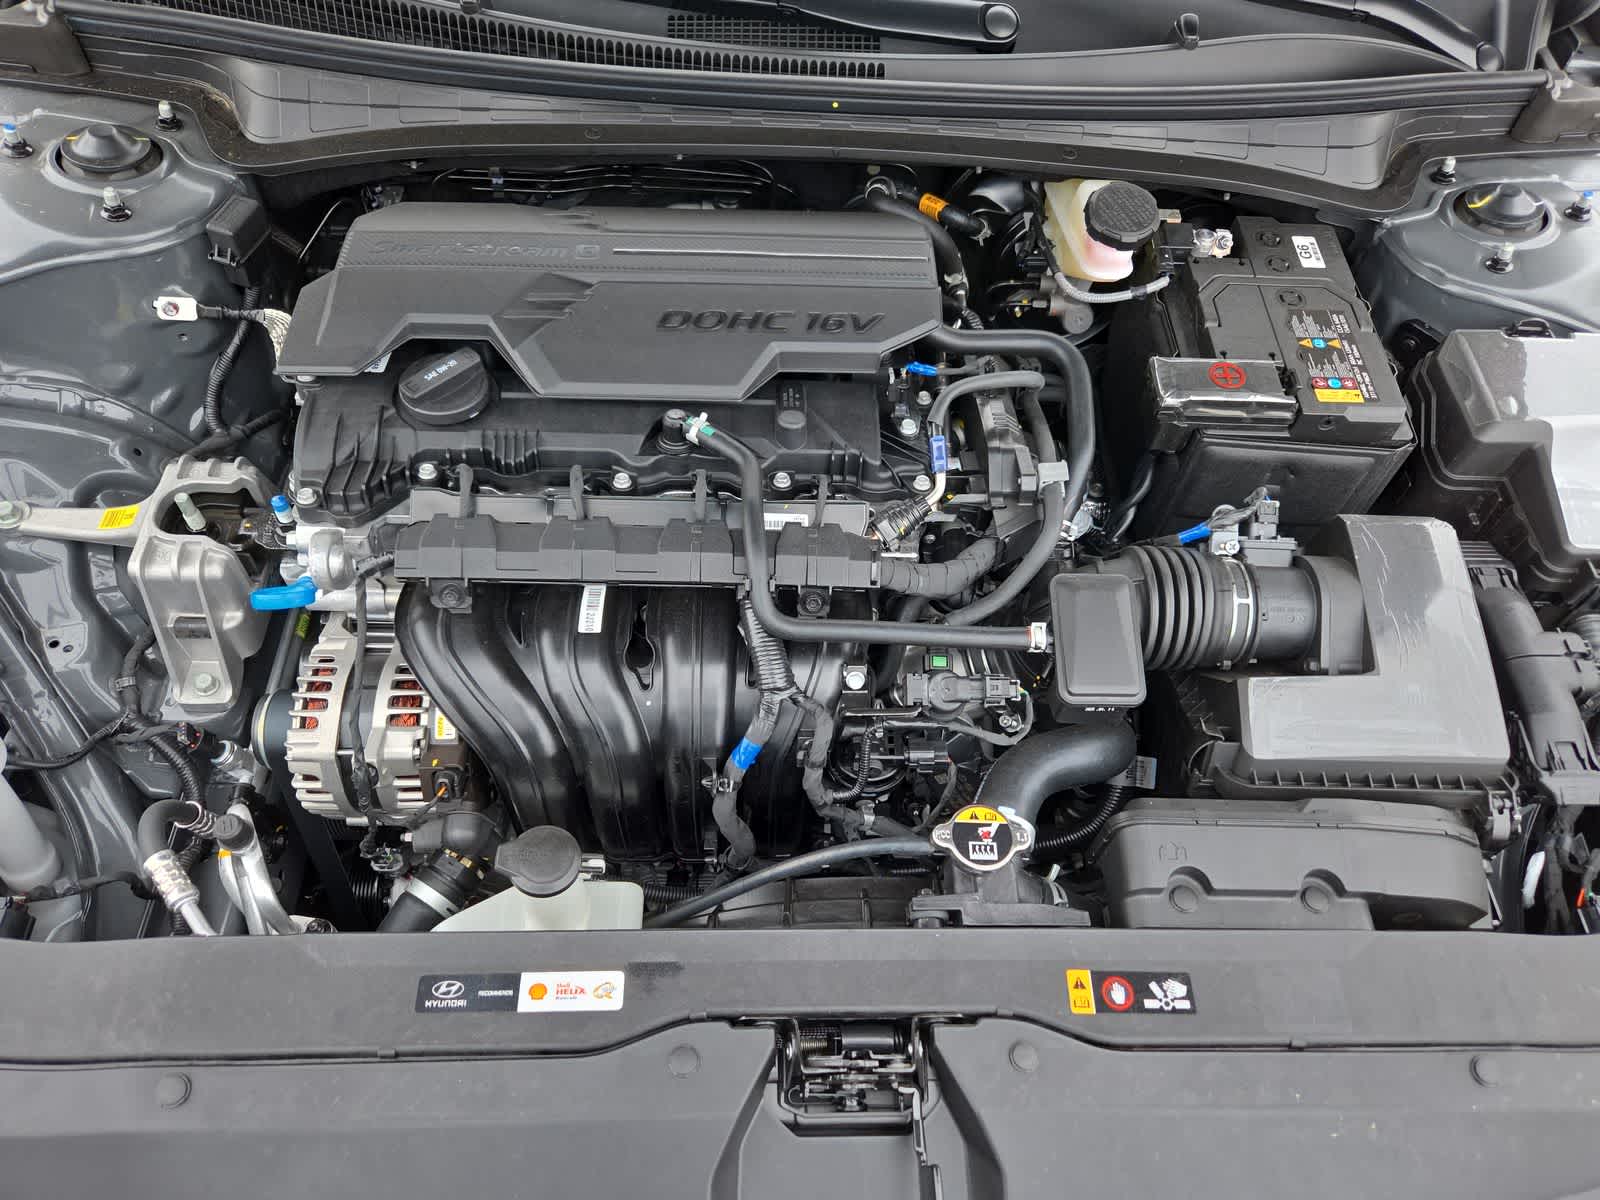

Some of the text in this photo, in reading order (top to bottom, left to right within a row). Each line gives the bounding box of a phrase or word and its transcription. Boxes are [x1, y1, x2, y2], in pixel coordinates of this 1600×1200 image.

[1297, 244, 1312, 259] G6
[657, 310, 886, 334] DOHC 16V
[556, 986, 587, 996] HELIX
[425, 999, 467, 1008] HYUNDAI
